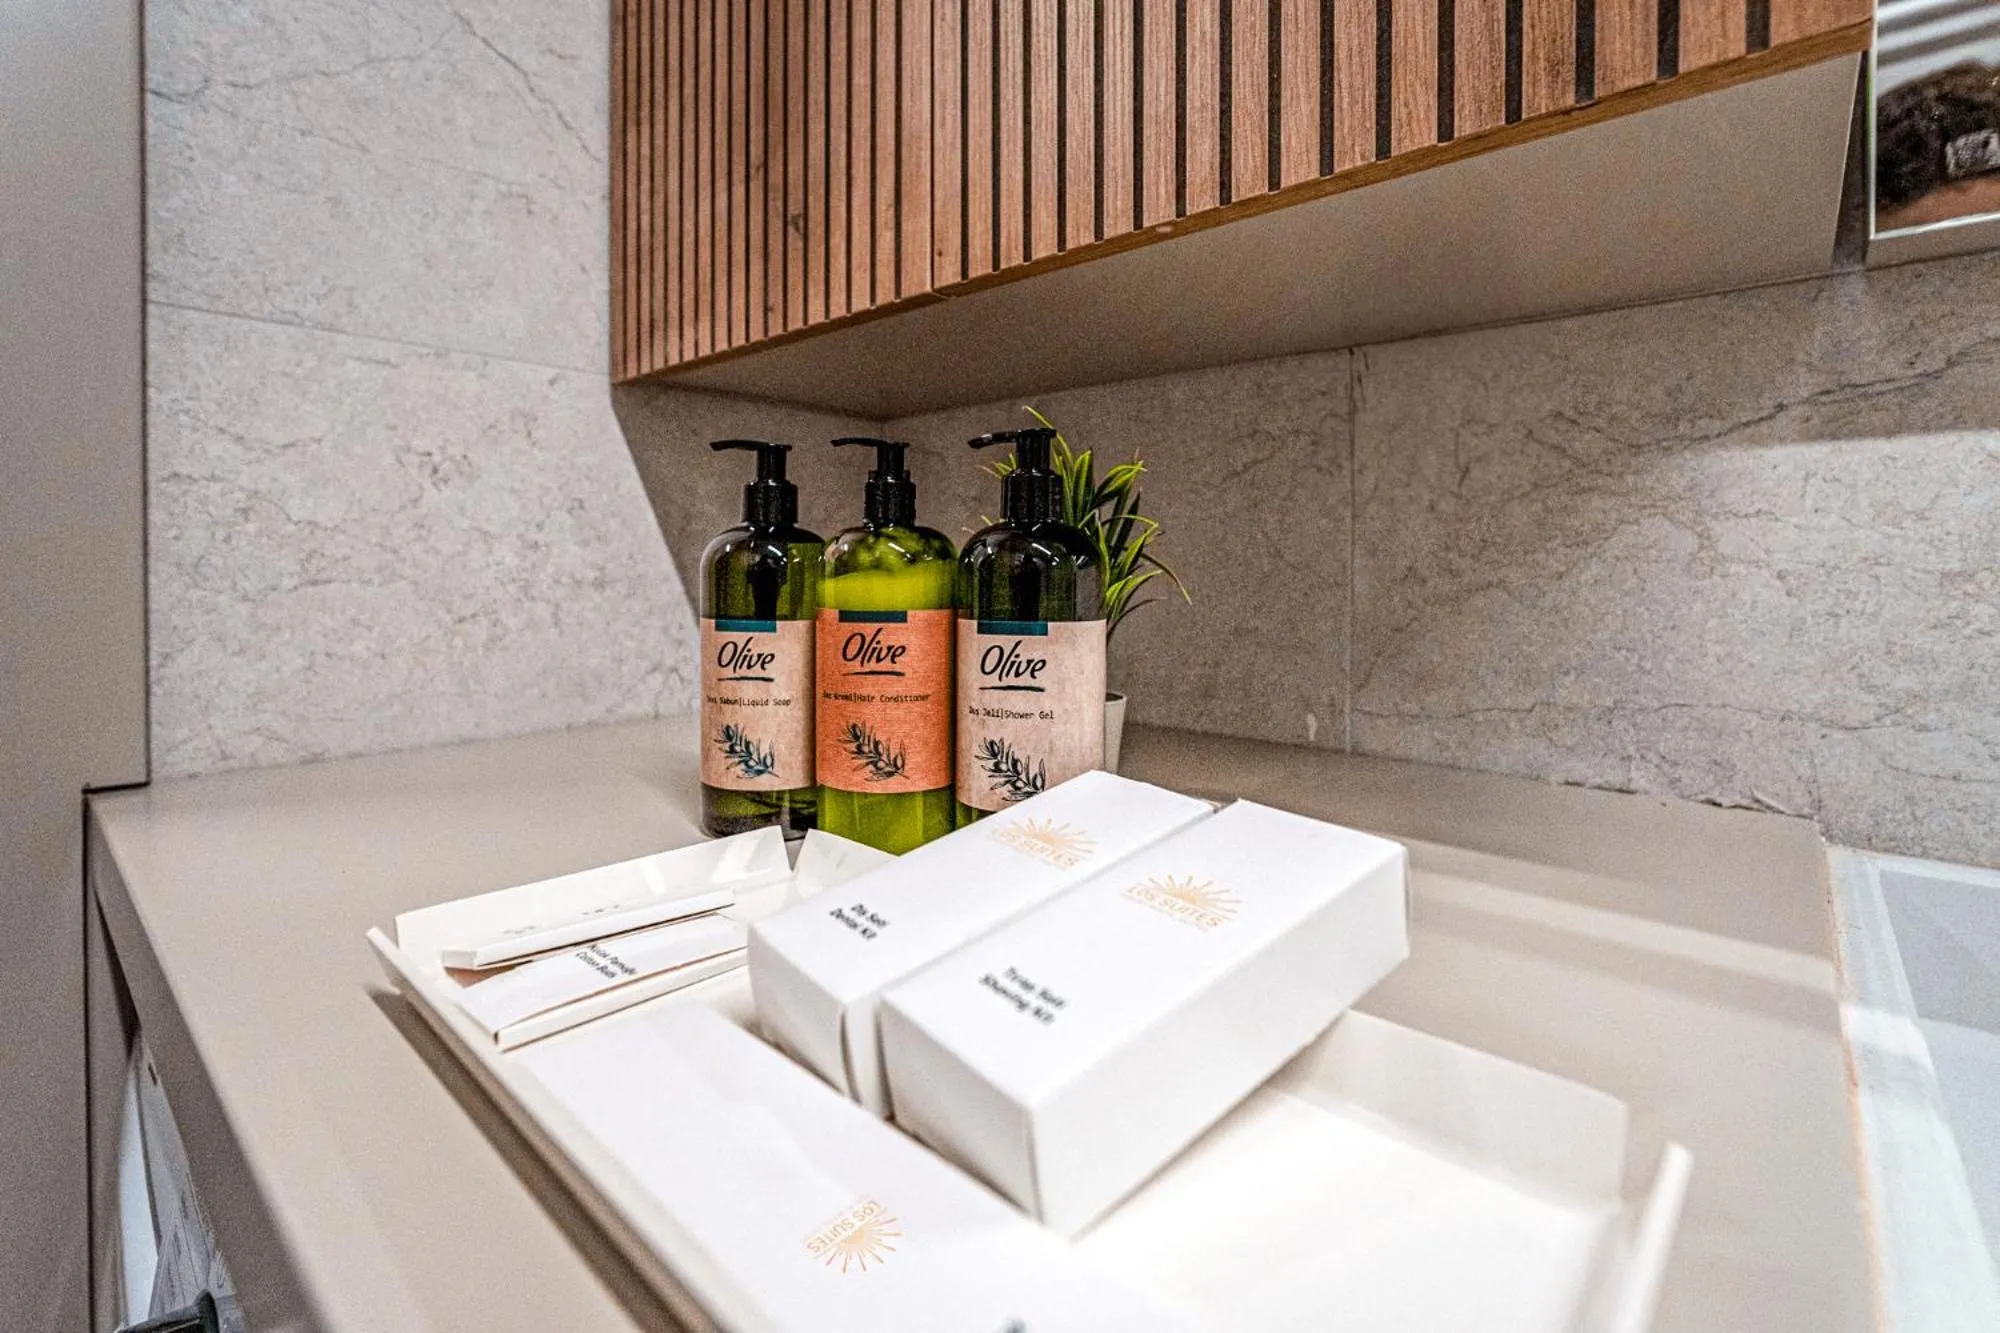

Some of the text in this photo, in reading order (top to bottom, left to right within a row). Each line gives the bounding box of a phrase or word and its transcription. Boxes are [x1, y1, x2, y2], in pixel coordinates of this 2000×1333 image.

[717, 636, 776, 673] Olive
[842, 627, 907, 668] Olive
[980, 640, 1047, 682] Olive
[773, 698, 792, 707] Soap
[880, 692, 932, 703] Conditioner
[1039, 710, 1054, 719] Gel
[806, 1199, 881, 1253] LOS SUITES
